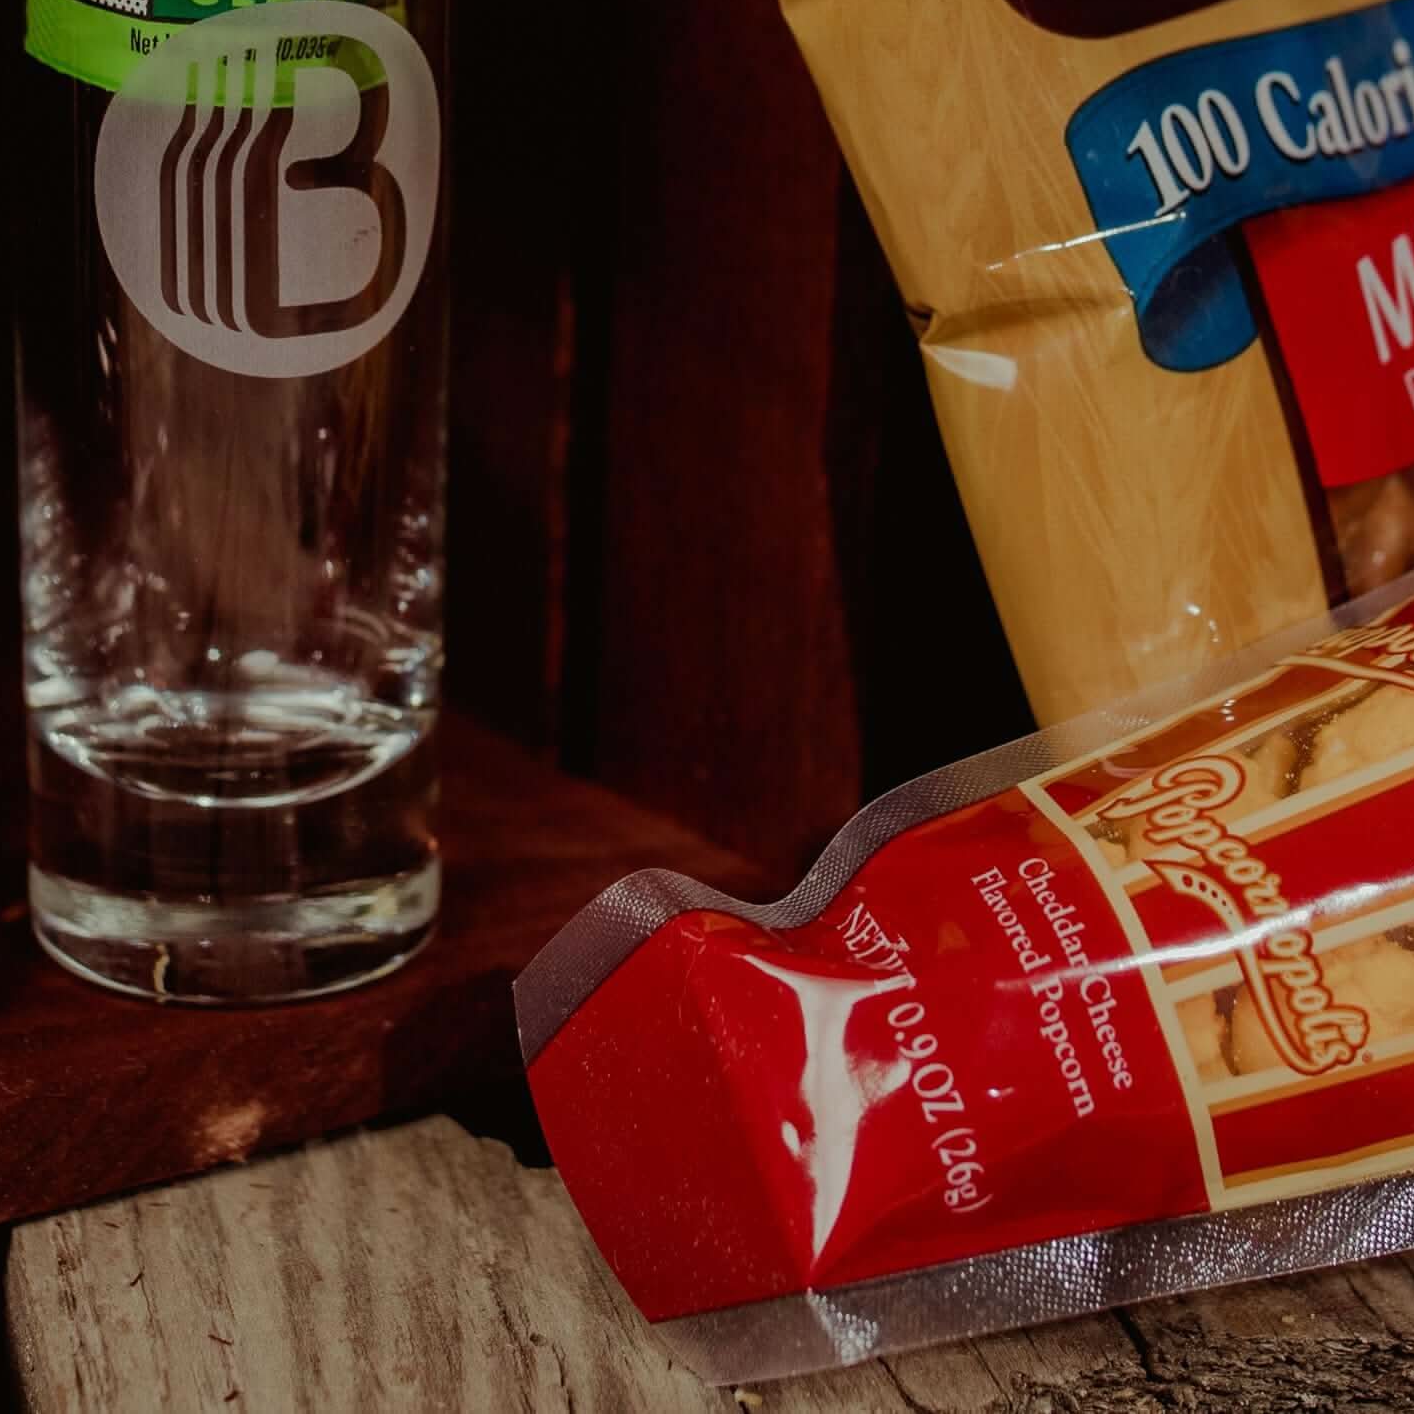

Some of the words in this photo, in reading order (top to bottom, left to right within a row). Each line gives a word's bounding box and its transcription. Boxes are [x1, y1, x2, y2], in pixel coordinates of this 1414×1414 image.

[1126, 89, 1251, 217] 100
[970, 866, 1052, 974] Flavored
[1031, 975, 1097, 1119] Popcorn
[1017, 855, 1089, 973] Cheddar
[1080, 973, 1134, 1090] Cheese
[931, 1126, 993, 1214] (26g)
